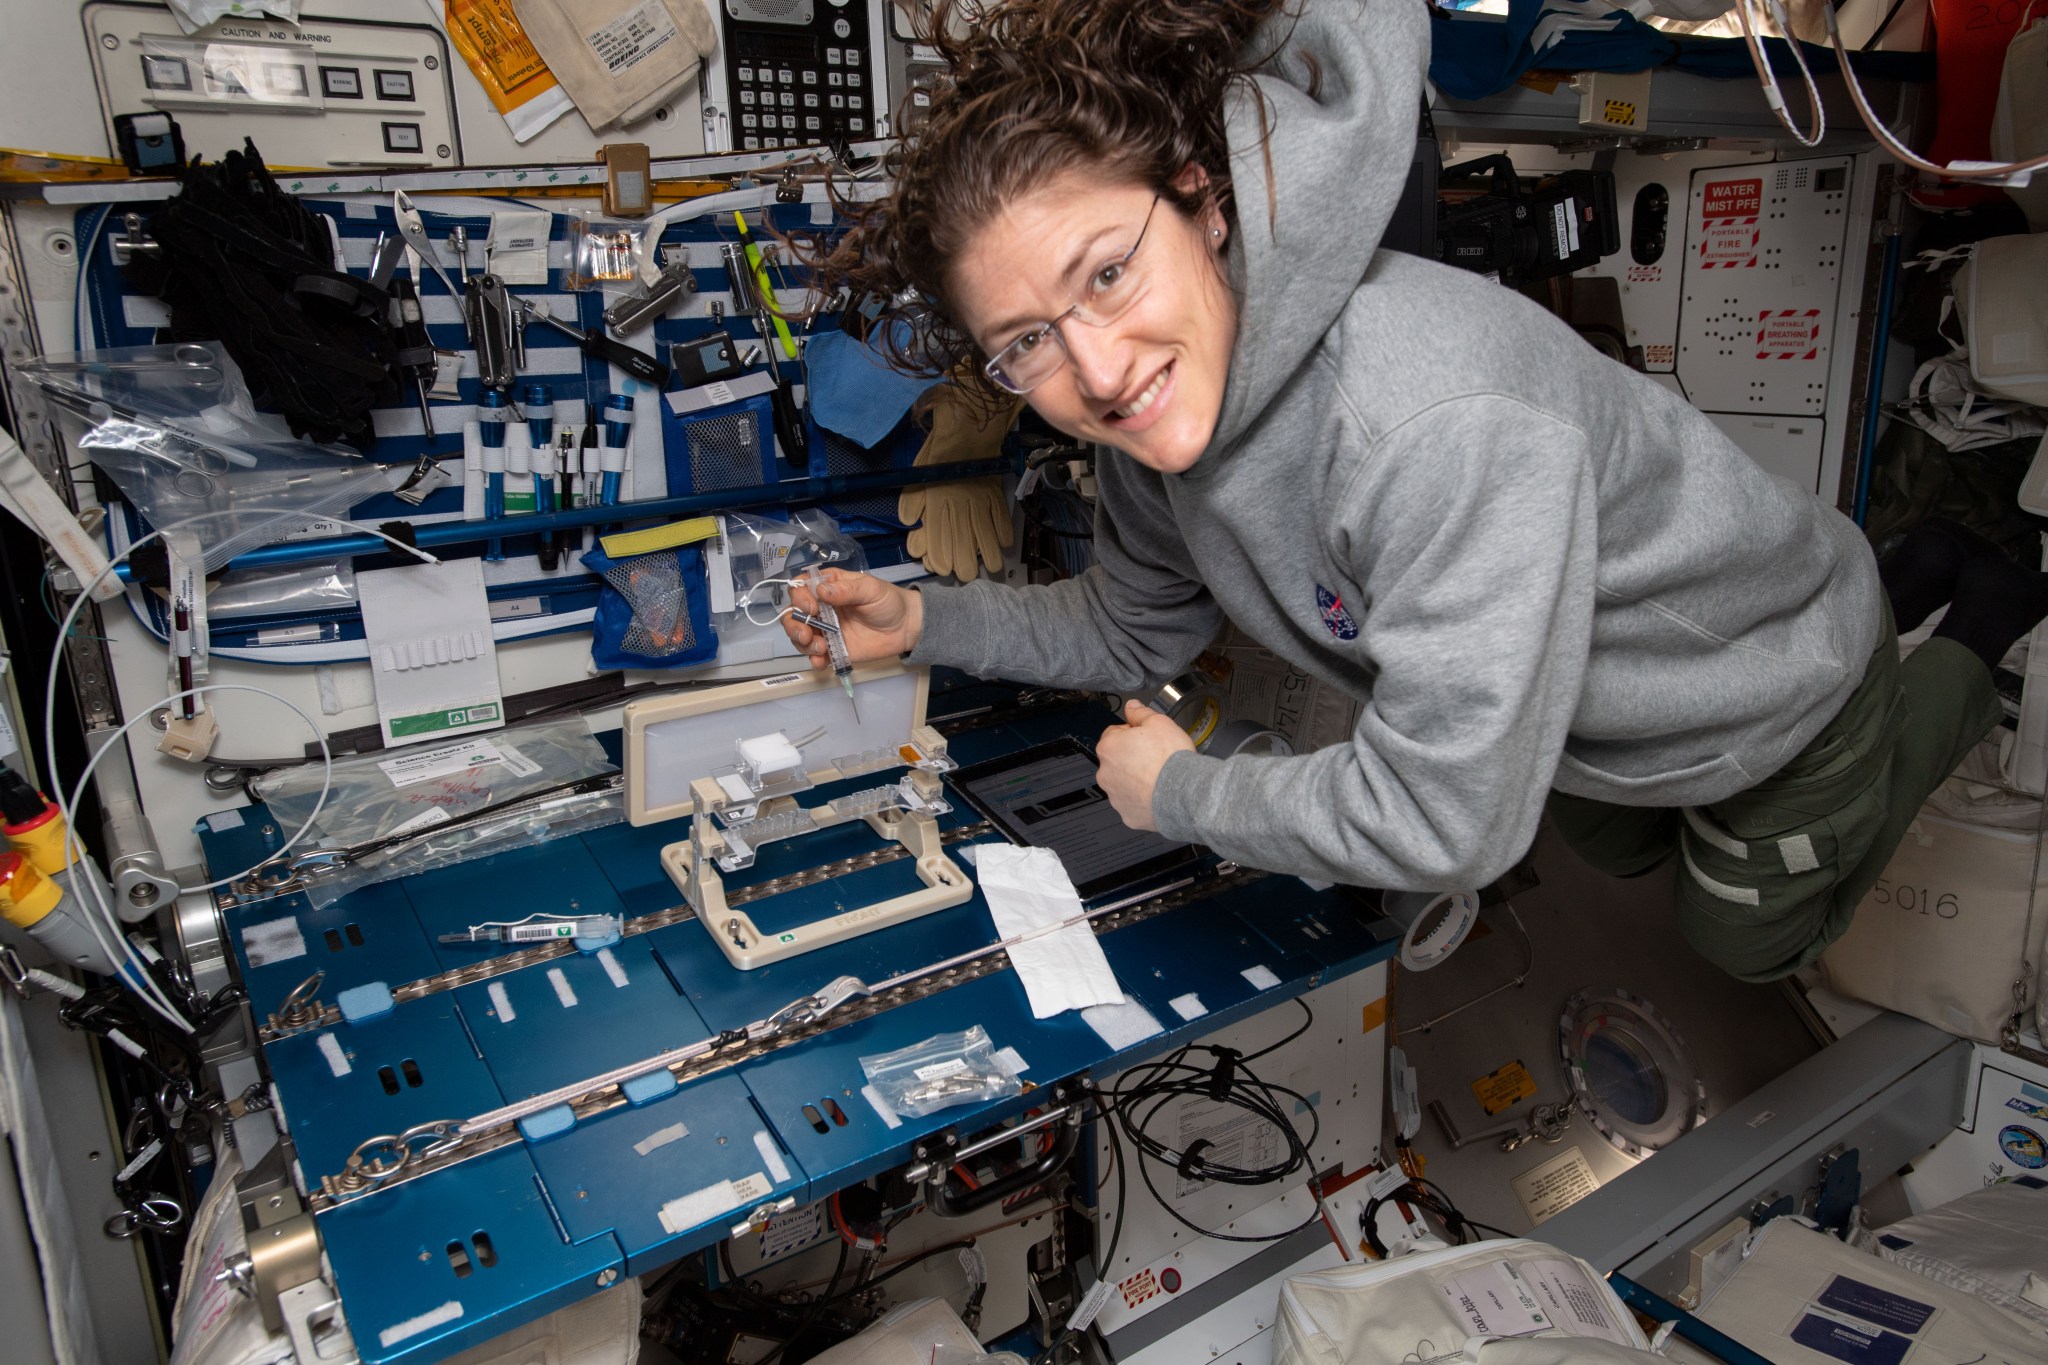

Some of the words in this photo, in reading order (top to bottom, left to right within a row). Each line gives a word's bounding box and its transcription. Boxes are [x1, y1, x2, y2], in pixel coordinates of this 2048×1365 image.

[221, 27, 261, 38] CAUTION
[268, 31, 286, 40] AND
[294, 33, 332, 43] WARNING
[609, 44, 640, 70] BOEING
[1712, 184, 1755, 198] WATER
[1706, 200, 1734, 212] MIST
[1736, 198, 1758, 210] PFE
[1556, 206, 1563, 216] DO
[1560, 228, 1568, 258] REMOVE
[1456, 247, 1484, 256] RED
[1718, 240, 1742, 248] FIRE
[396, 754, 432, 764] Science
[433, 748, 460, 757] Ersatz
[1874, 882, 1960, 920] 5016
[1128, 1288, 1140, 1297] FIRE
[1140, 1282, 1152, 1292] PORT
[1487, 1288, 1504, 1311] CAPILLARY
